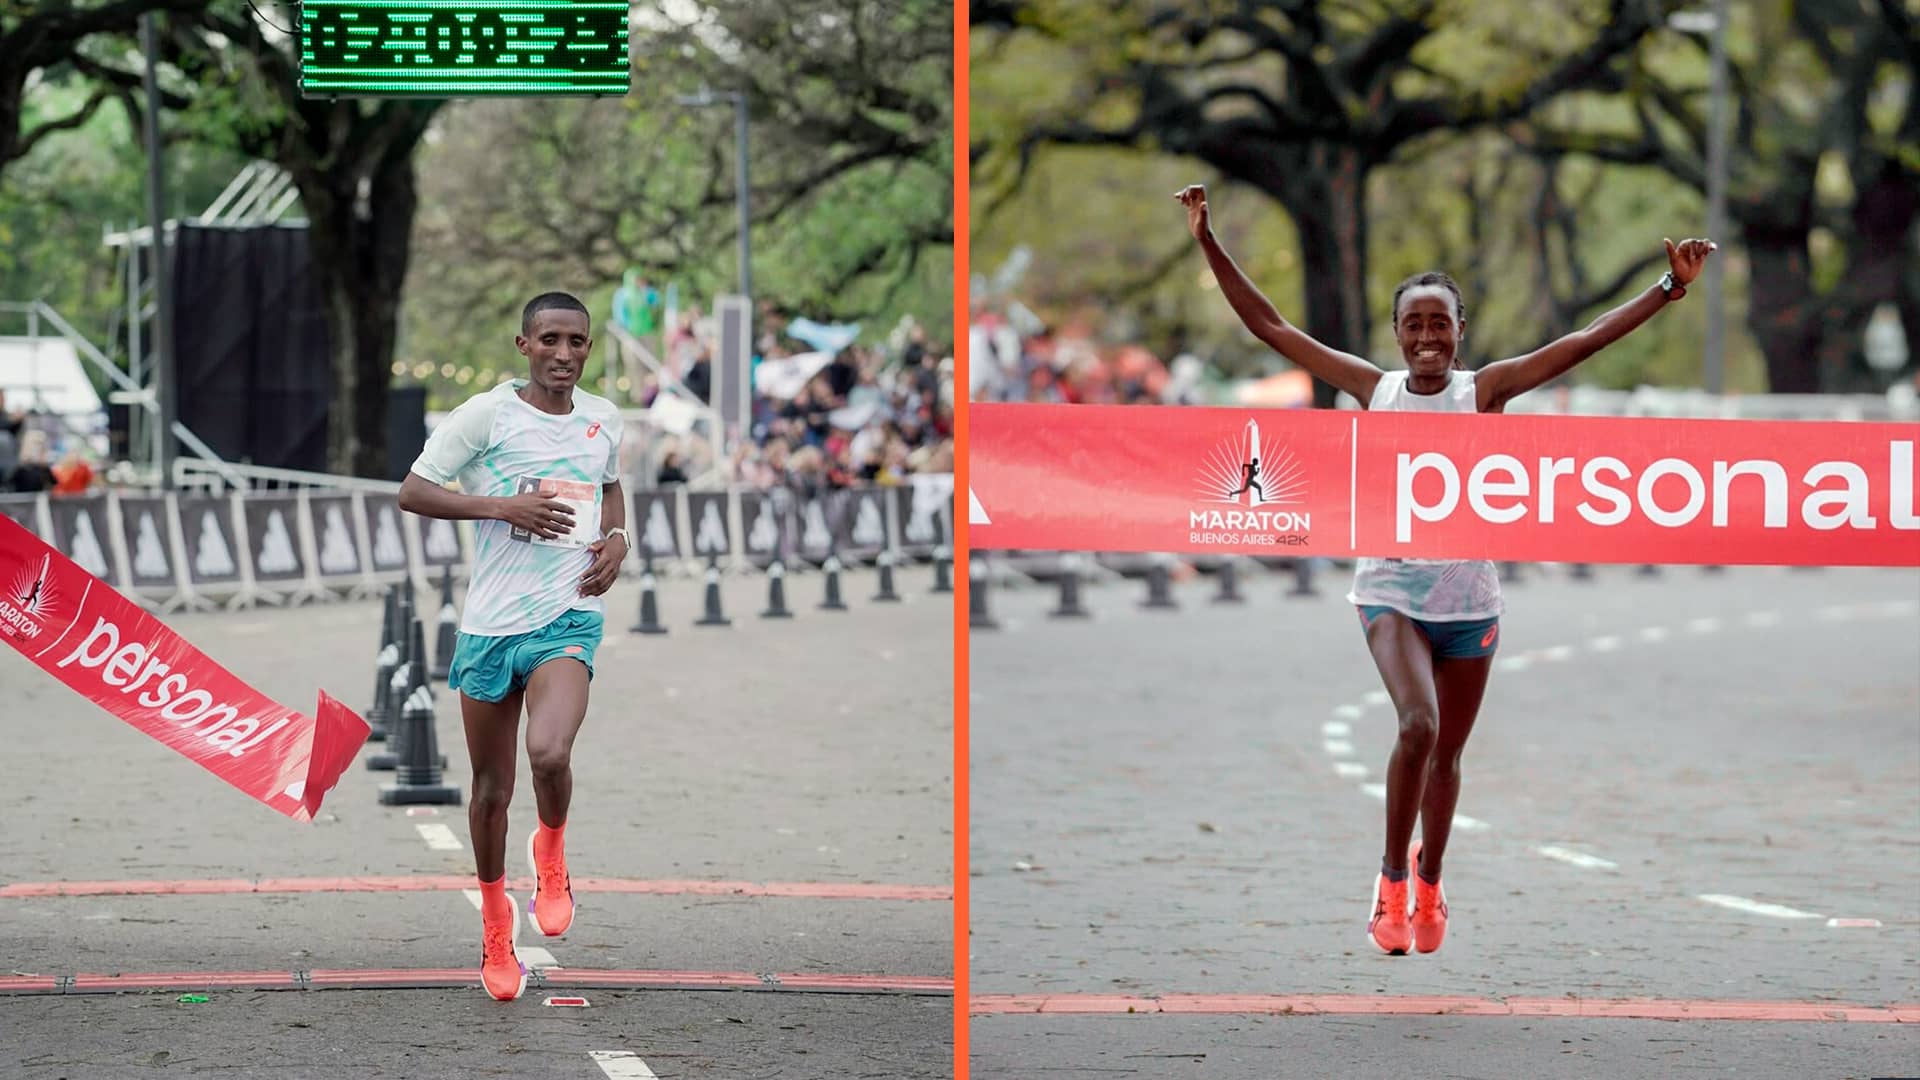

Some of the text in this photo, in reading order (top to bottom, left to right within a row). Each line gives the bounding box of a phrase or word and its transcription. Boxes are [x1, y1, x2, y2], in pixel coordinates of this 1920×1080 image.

[1189, 510, 1311, 531] MARATON
[1396, 440, 1920, 543] personal
[1189, 532, 1309, 546] BUENOS AIRES 42K
[57, 616, 287, 757] personal
